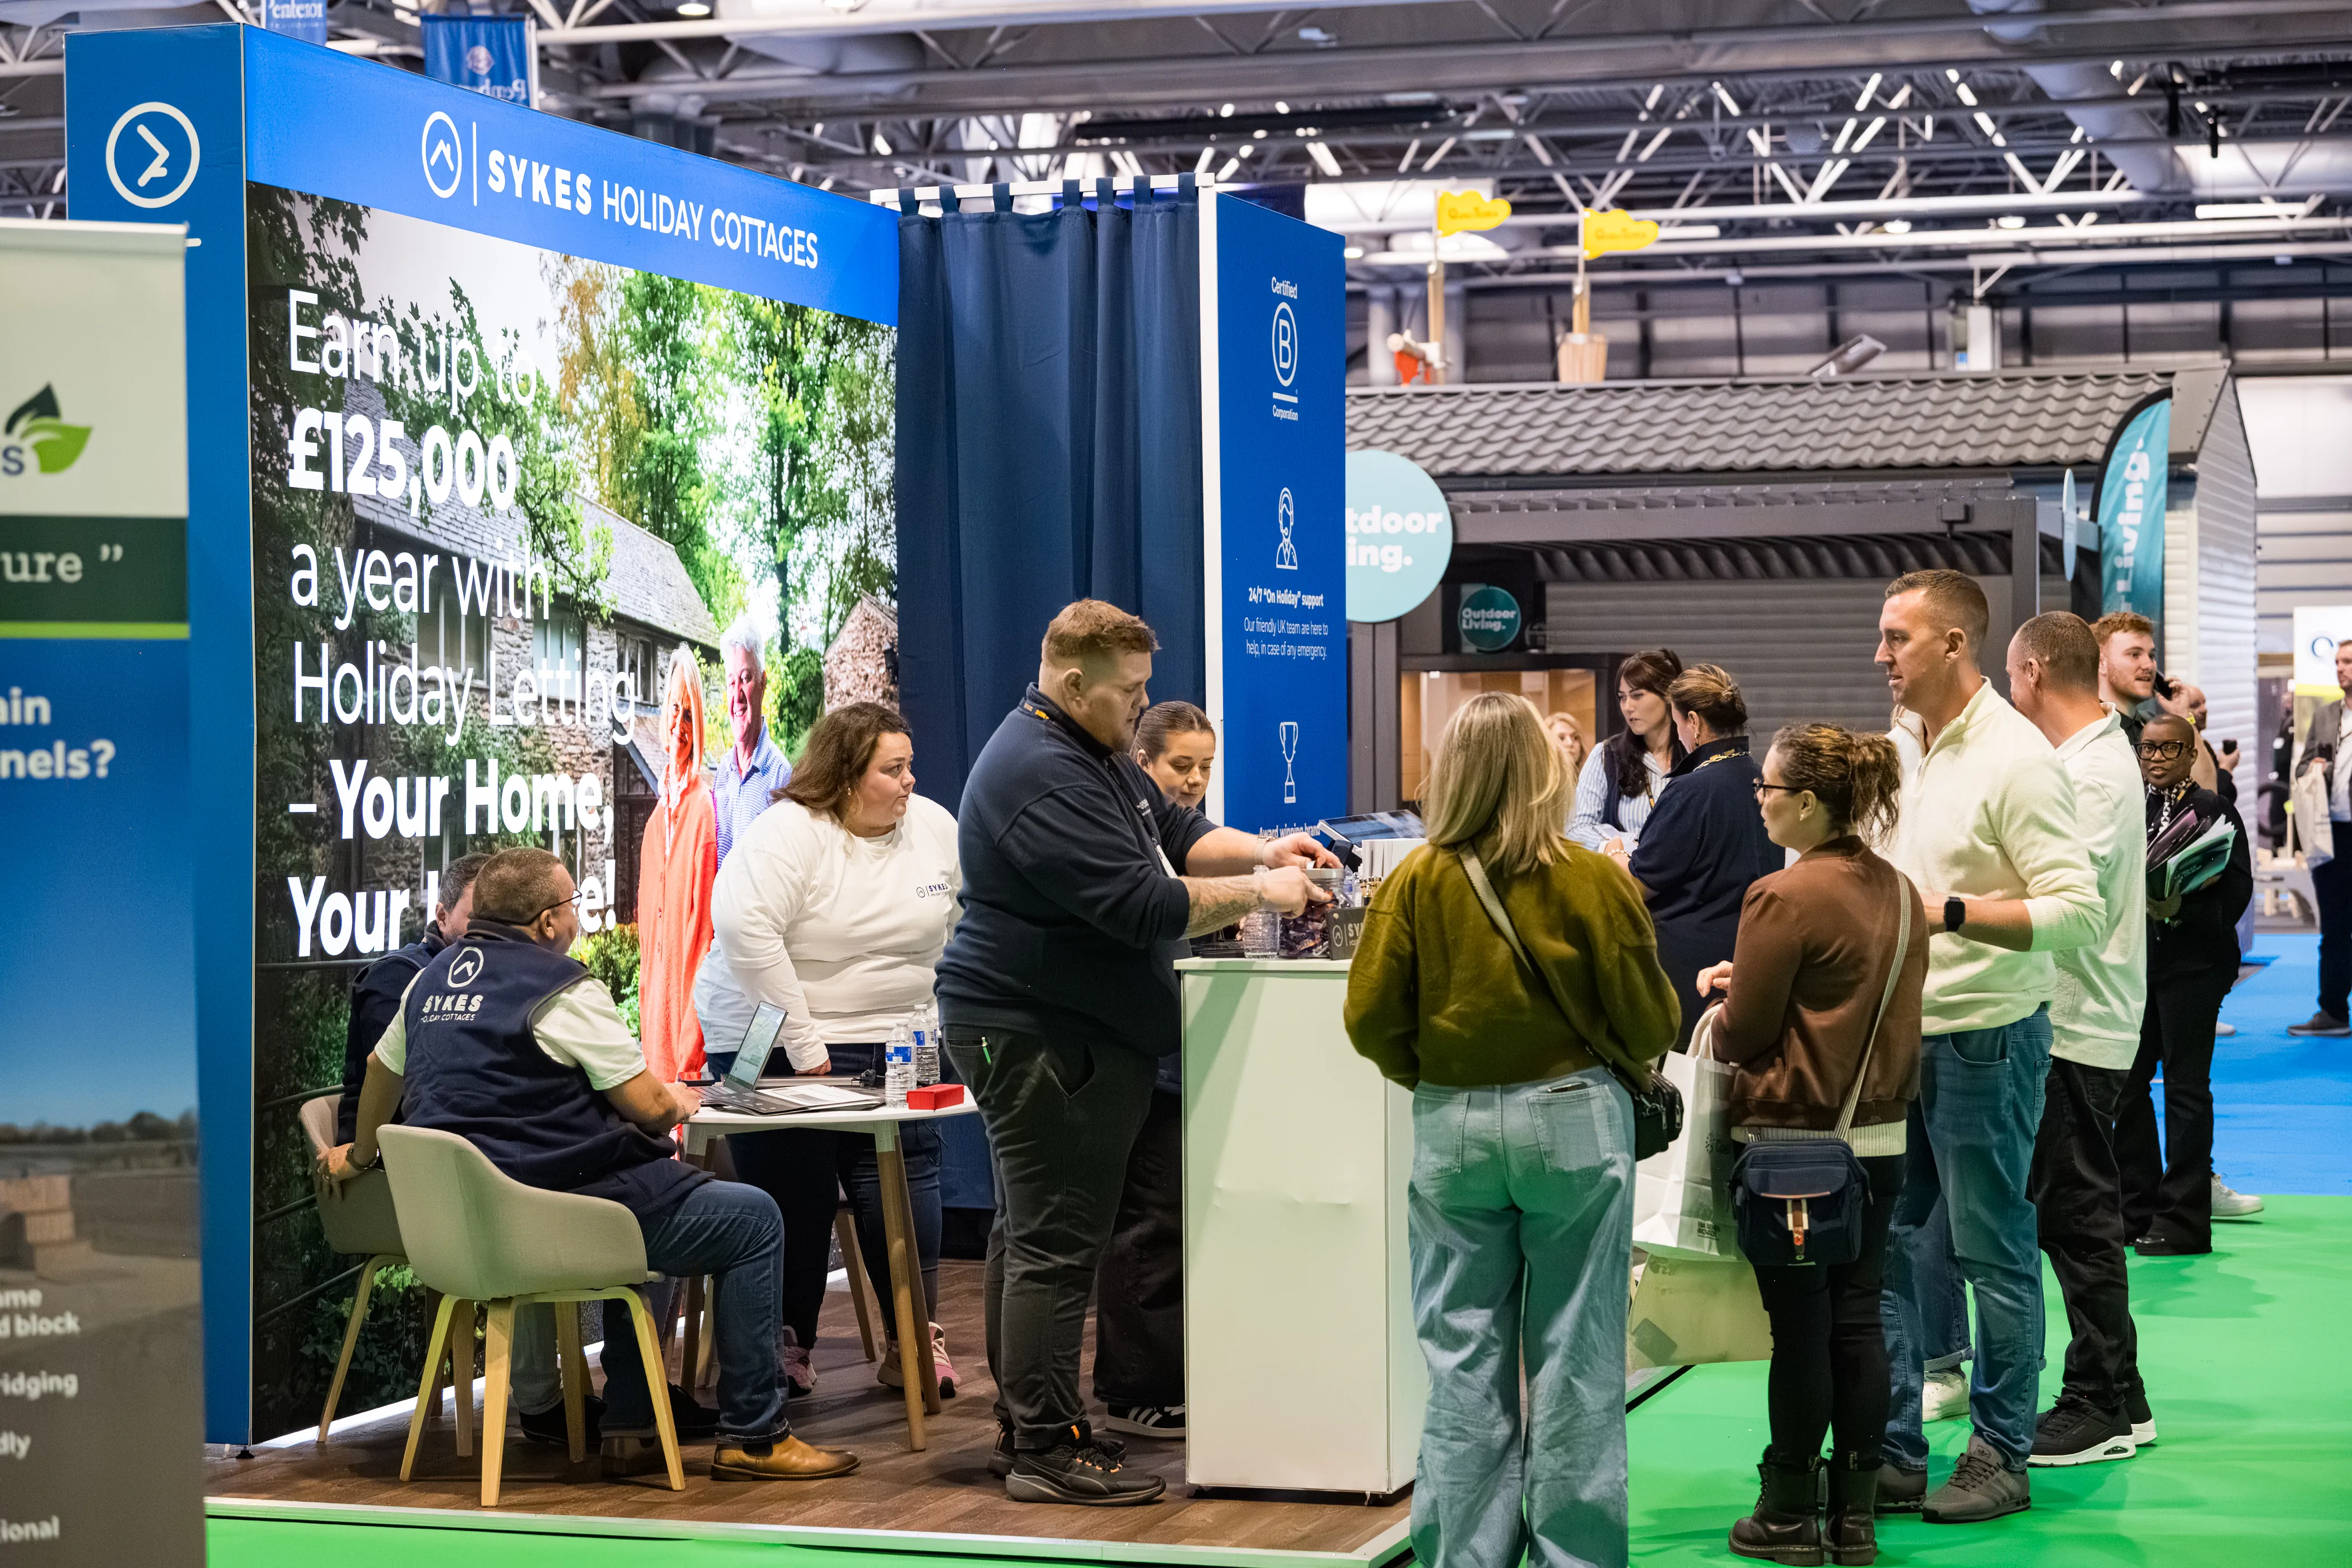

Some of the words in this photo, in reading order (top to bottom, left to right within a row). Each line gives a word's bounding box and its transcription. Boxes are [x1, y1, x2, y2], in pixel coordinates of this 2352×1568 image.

[488, 149, 592, 215] SYKES
[602, 179, 704, 241] HOLIDAY
[710, 208, 819, 269] COTTAGES
[1271, 276, 1298, 299] Certified
[288, 288, 401, 386] Earn
[419, 330, 479, 416] up
[492, 332, 538, 407] to
[1278, 318, 1291, 369] B
[1272, 404, 1299, 421] Corporation
[287, 407, 517, 518] £125,000
[291, 543, 318, 606] a
[334, 545, 439, 631] year
[451, 536, 549, 620] with
[1248, 585, 1263, 604] 24/7
[1301, 594, 1324, 609] support
[1462, 608, 1516, 619] Outdoor
[1462, 618, 1506, 632] Living.
[1244, 617, 1256, 632] Our
[1256, 617, 1276, 637] friendly
[1277, 619, 1286, 633] UK
[1286, 621, 1301, 634] team
[1301, 623, 1310, 634] are
[1310, 620, 1322, 635] here
[1322, 623, 1328, 635] to
[1246, 639, 1261, 659] help,
[1261, 640, 1267, 655] in
[1267, 644, 1280, 655] case
[1280, 641, 1287, 656] of
[1287, 645, 1297, 660] any
[1297, 646, 1327, 660] emergency.
[294, 639, 474, 747] Holiday
[489, 647, 636, 745] Letting
[329, 759, 449, 840] Your
[465, 758, 614, 844] Home,
[1259, 825, 1278, 838] Award
[928, 883, 948, 892] SYKES
[287, 875, 410, 958] Your
[422, 993, 484, 1013] SYKES
[441, 1013, 476, 1021] COTTAGES
[15, 1310, 81, 1339] block
